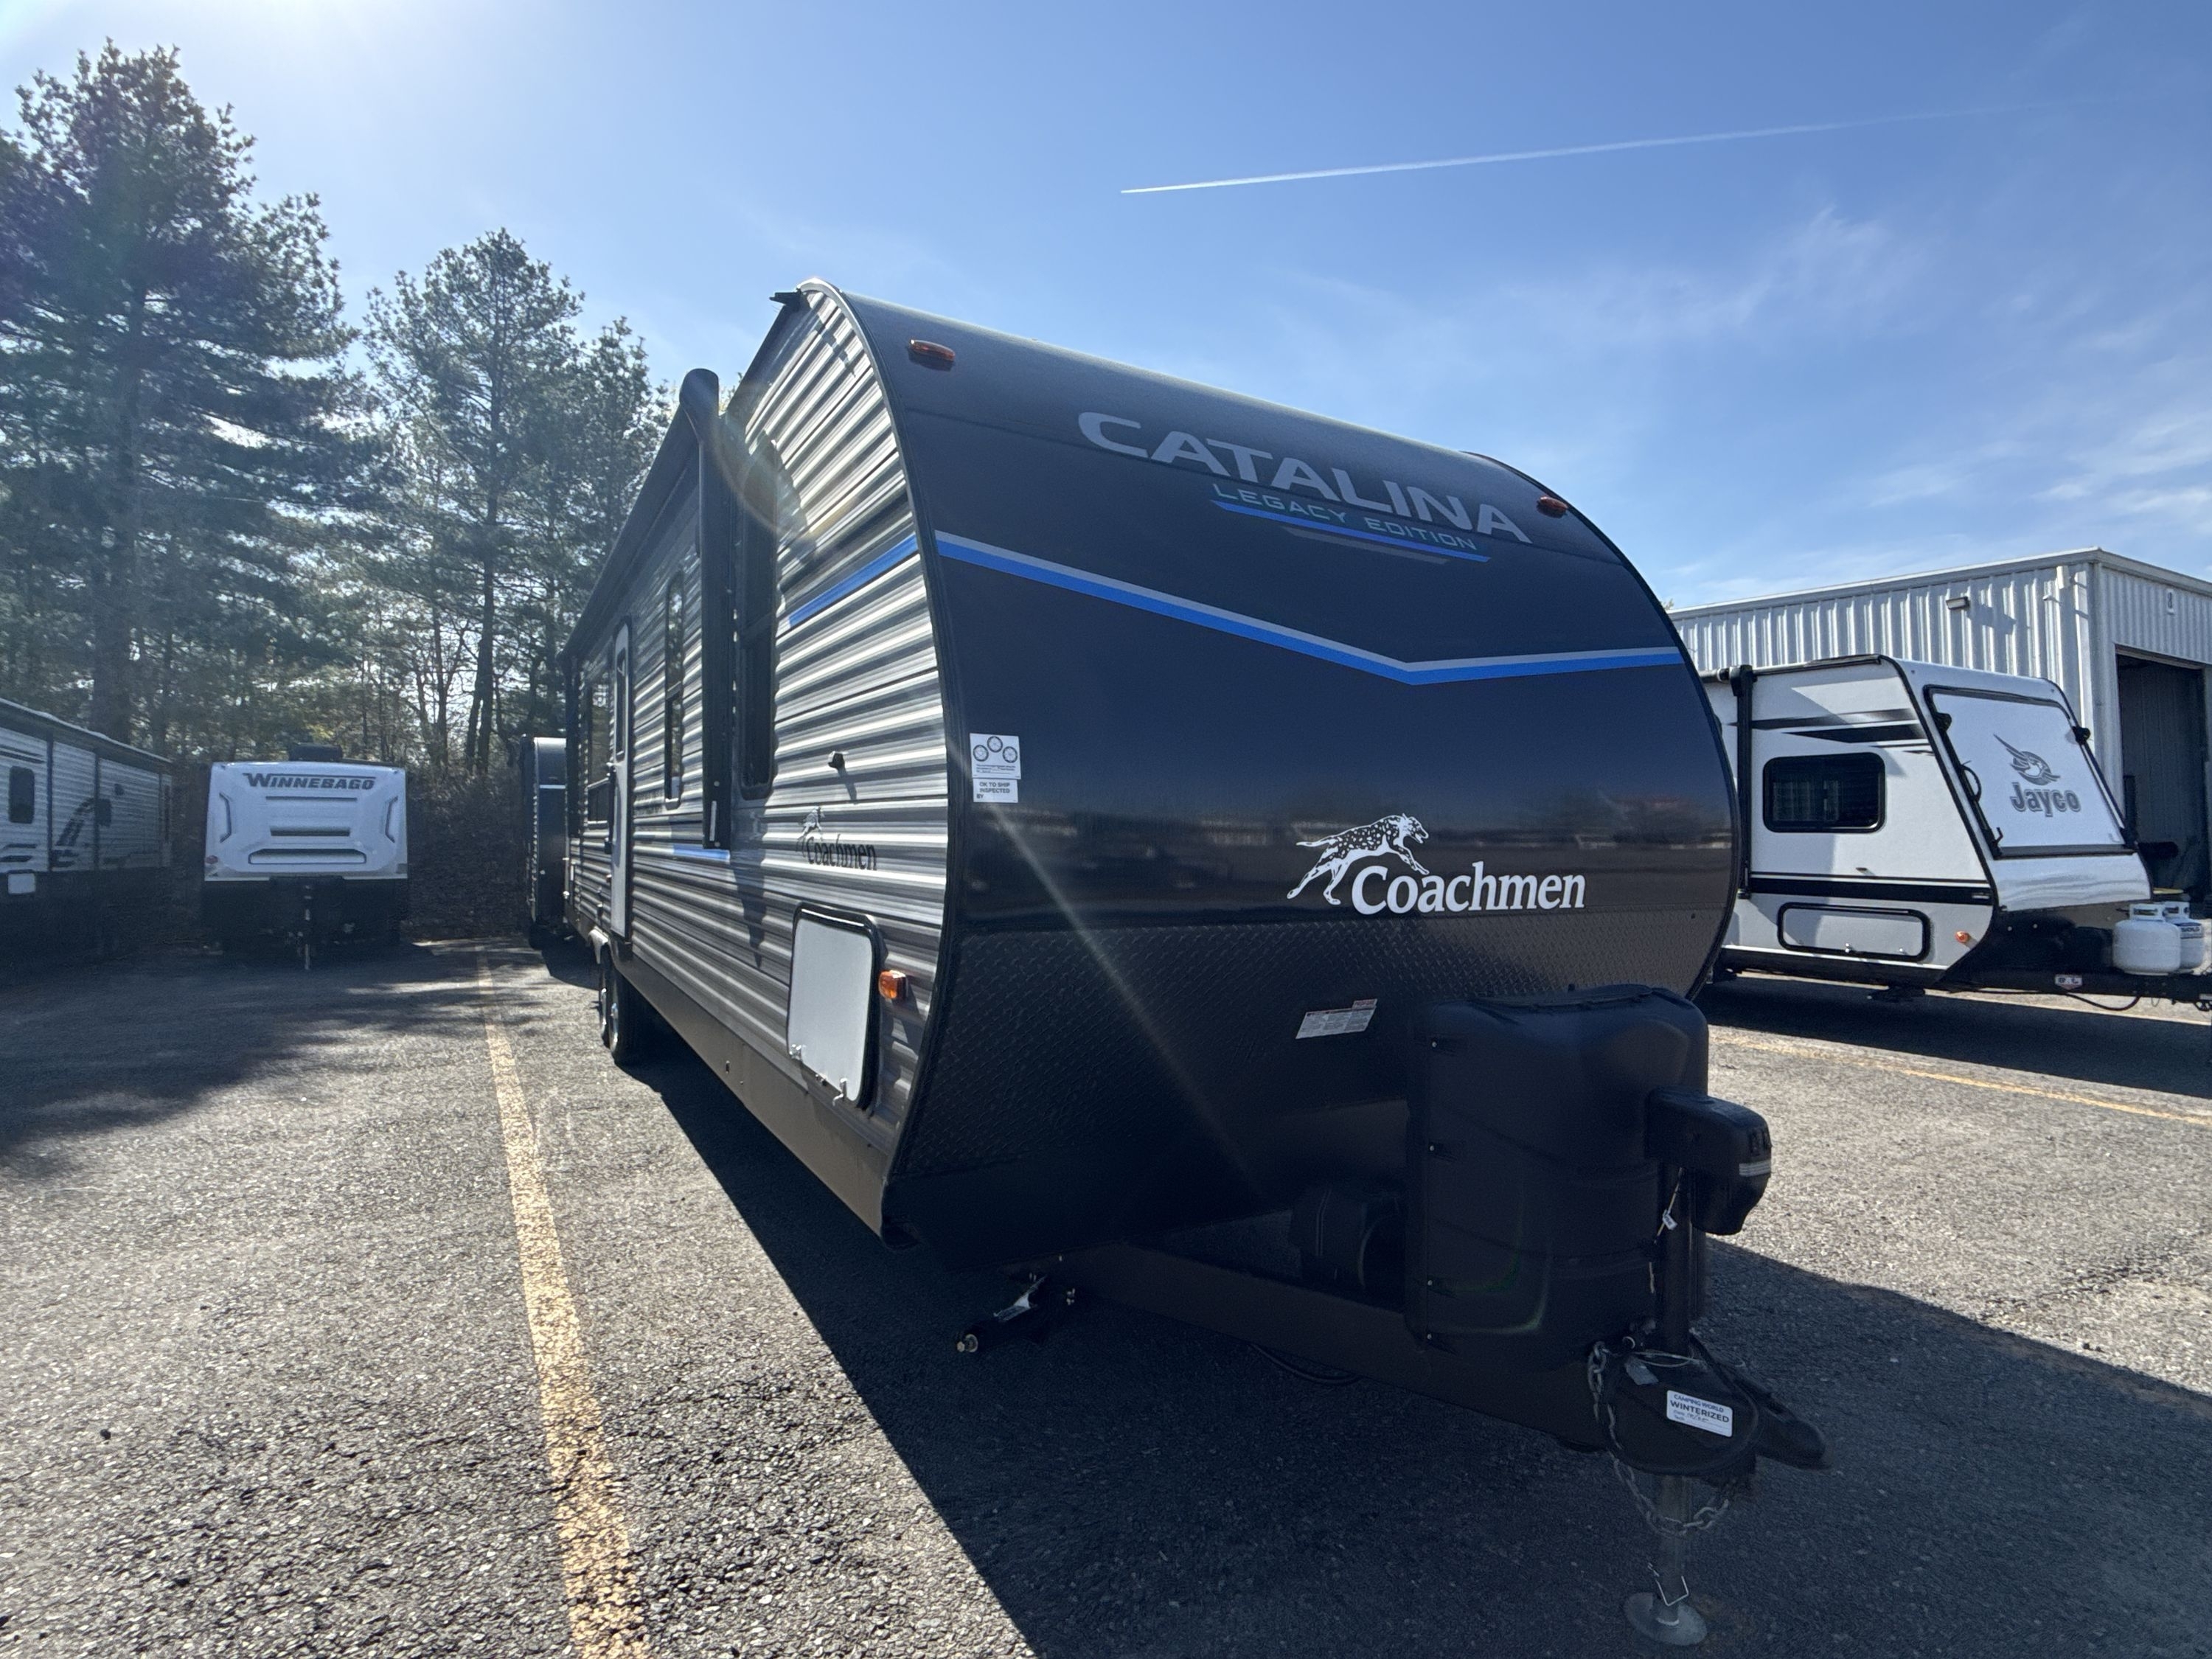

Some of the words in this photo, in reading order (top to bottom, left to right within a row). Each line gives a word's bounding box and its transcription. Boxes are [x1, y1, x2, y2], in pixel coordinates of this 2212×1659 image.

[1078, 411, 1532, 543] CATALINA
[1213, 483, 1346, 524] LEGACY
[1363, 517, 1478, 550] EDITION
[243, 773, 377, 790] WINNEBAGO
[2010, 782, 2081, 818] Jayco
[807, 833, 877, 870] Coachmen
[1352, 861, 1586, 915] Coachmen
[1670, 1400, 1729, 1422] WINTERIZED
[1701, 1402, 1724, 1413] WORLD
